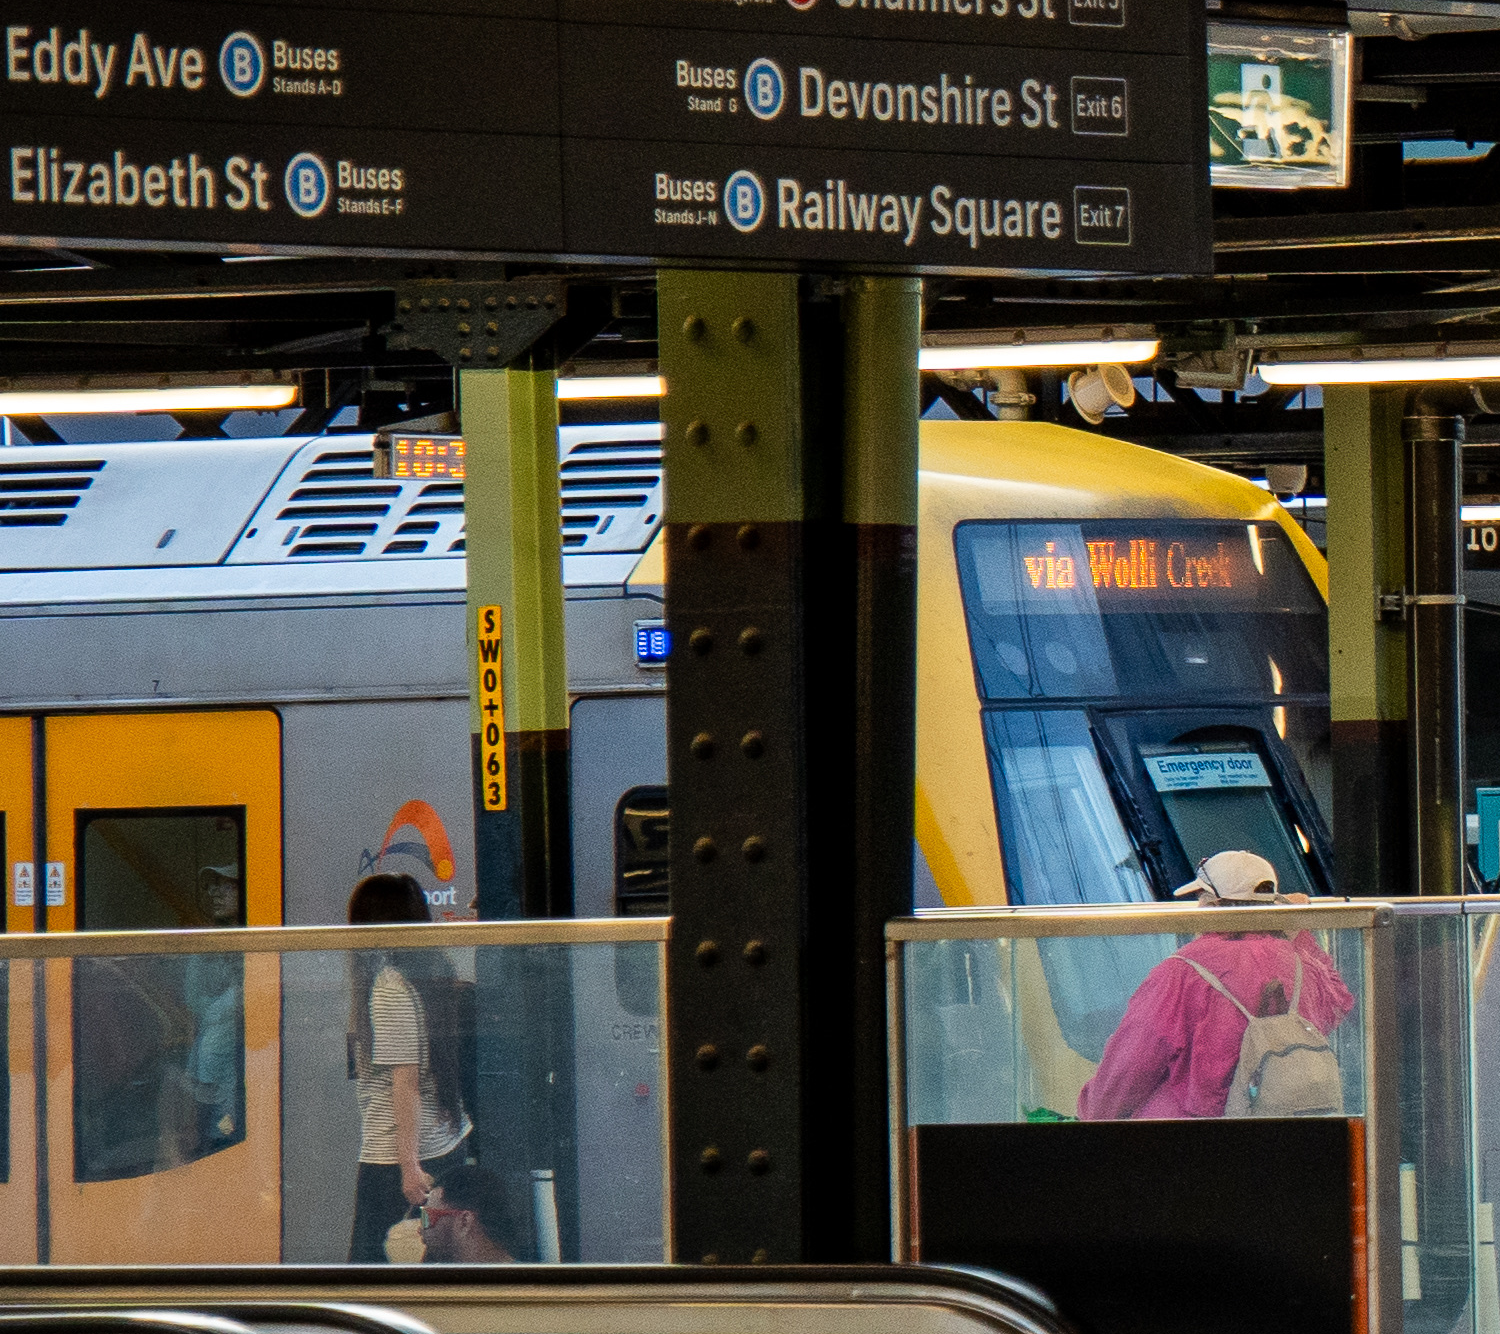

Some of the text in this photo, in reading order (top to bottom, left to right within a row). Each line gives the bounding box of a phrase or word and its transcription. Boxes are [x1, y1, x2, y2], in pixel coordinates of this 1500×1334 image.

[6, 26, 118, 98] Eddy
[126, 32, 205, 89] Ave
[272, 40, 339, 71] Buses
[272, 76, 341, 95] Stands A-D
[676, 61, 736, 90] Buses
[800, 67, 1012, 126] Devonshire
[1020, 79, 1059, 128] St
[1076, 96, 1108, 118] Exit
[1112, 96, 1122, 118] 6
[688, 96, 737, 112] Stand G
[11, 146, 215, 209] Elizabeth
[225, 156, 271, 212] St
[337, 161, 403, 192] Buses
[337, 196, 403, 215] Stands E-F
[655, 208, 717, 225] Stands J-N
[656, 173, 716, 203] Buses
[778, 179, 922, 245] Railway
[930, 185, 1062, 248] Square
[1080, 204, 1112, 228] Exit
[1115, 205, 1125, 228] 7
[1467, 527, 1498, 552] 10
[1024, 539, 1232, 588] via Wolli Creek
[152, 680, 160, 692] 7
[1157, 757, 1253, 774] Emergency door
